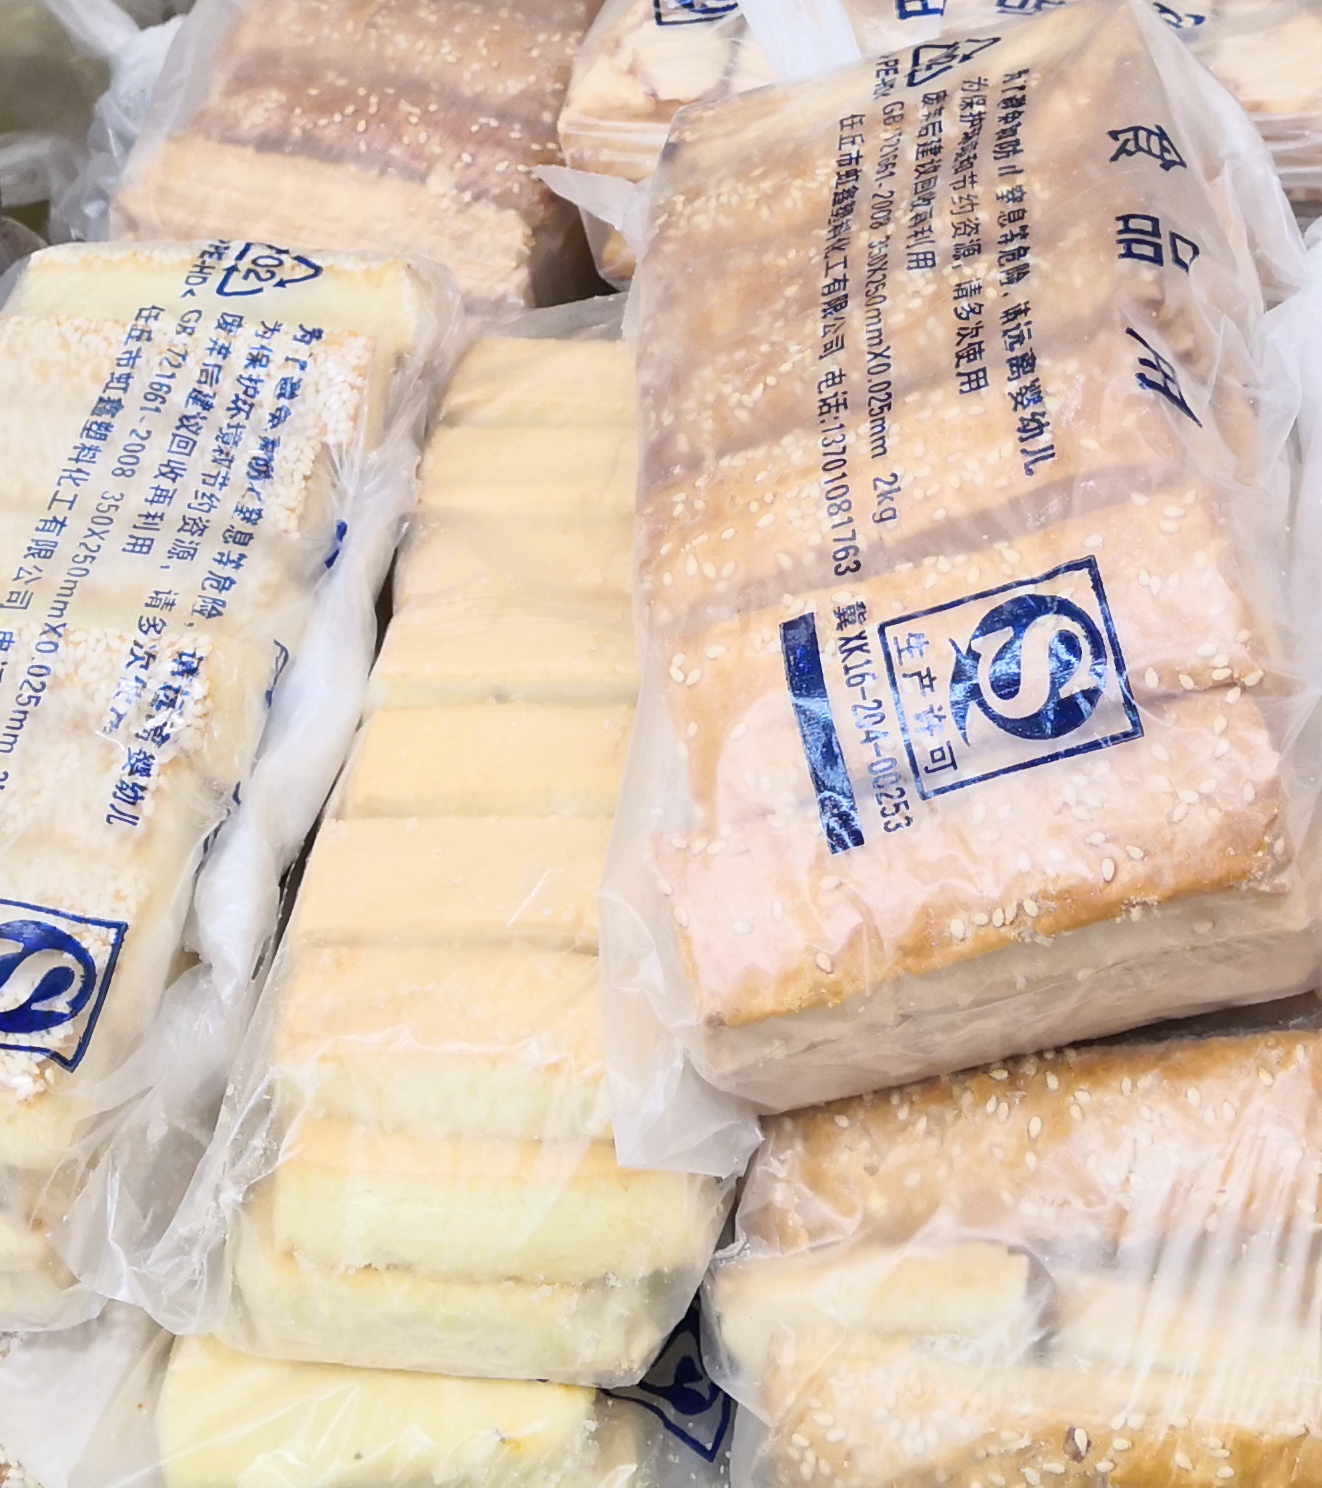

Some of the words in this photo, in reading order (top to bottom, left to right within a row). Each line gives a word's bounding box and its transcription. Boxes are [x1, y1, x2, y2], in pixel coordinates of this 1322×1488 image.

[871, 472, 899, 523] 2kg
[892, 630, 957, 774] 生产许可
